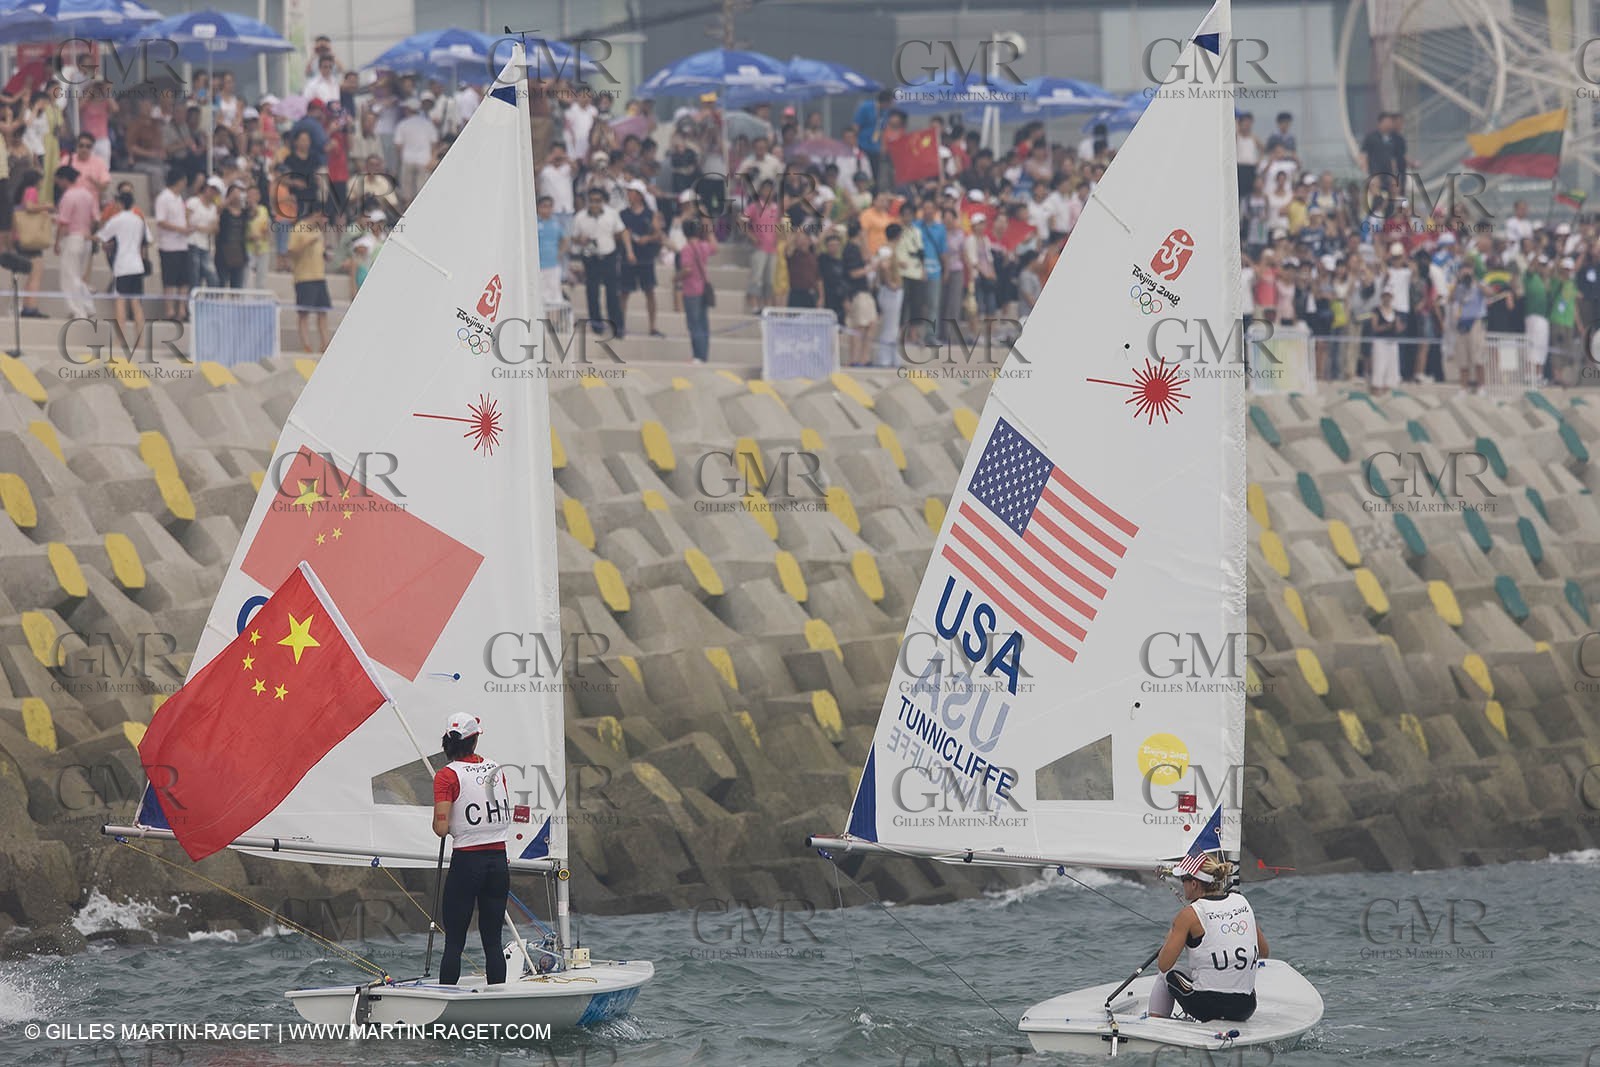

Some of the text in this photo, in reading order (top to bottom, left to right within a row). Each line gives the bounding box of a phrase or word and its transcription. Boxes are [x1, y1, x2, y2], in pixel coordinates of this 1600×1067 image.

[1132, 264, 1157, 292] Beijing
[456, 307, 485, 333] Beijing
[935, 575, 1022, 696] USA
[898, 695, 1015, 800] TUNNICLIFFE
